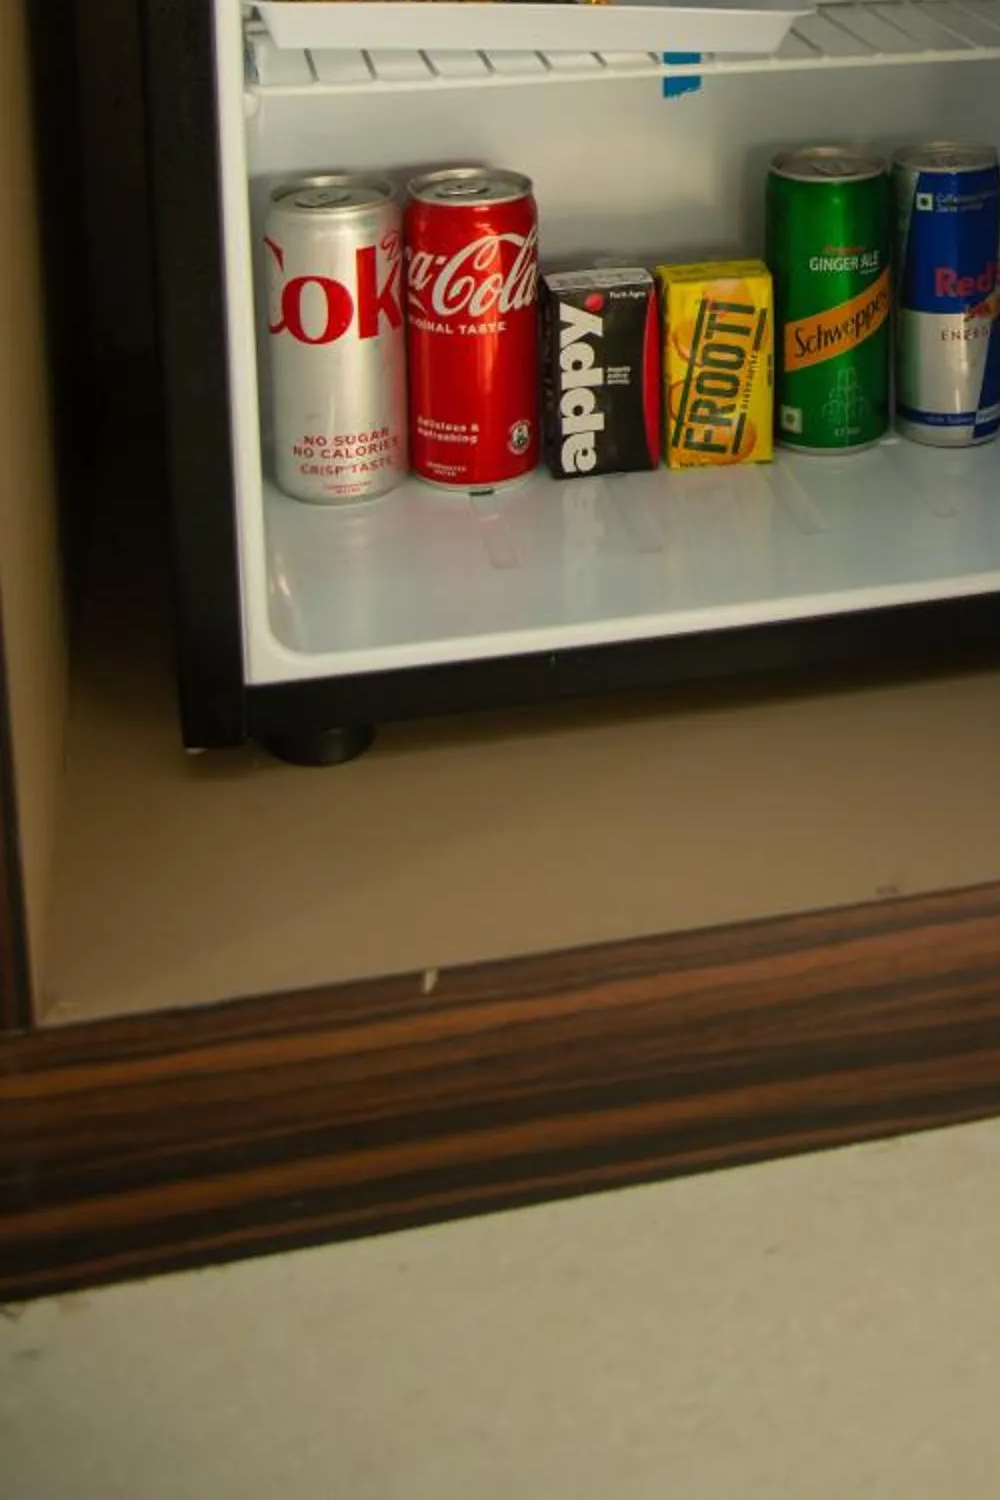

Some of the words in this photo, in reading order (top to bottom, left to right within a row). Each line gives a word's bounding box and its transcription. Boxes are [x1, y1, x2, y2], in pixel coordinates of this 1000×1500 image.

[809, 256, 859, 272] GINGER
[860, 250, 880, 268] ALE
[934, 263, 994, 297] Red
[458, 321, 507, 335] TASTE
[794, 291, 888, 358] Schweppe
[559, 302, 605, 474] appy
[684, 301, 755, 455] FROOTI
[303, 435, 327, 447] NO
[333, 426, 389, 447] SUGAR
[293, 445, 314, 459] NO
[300, 462, 345, 476] CRISP
